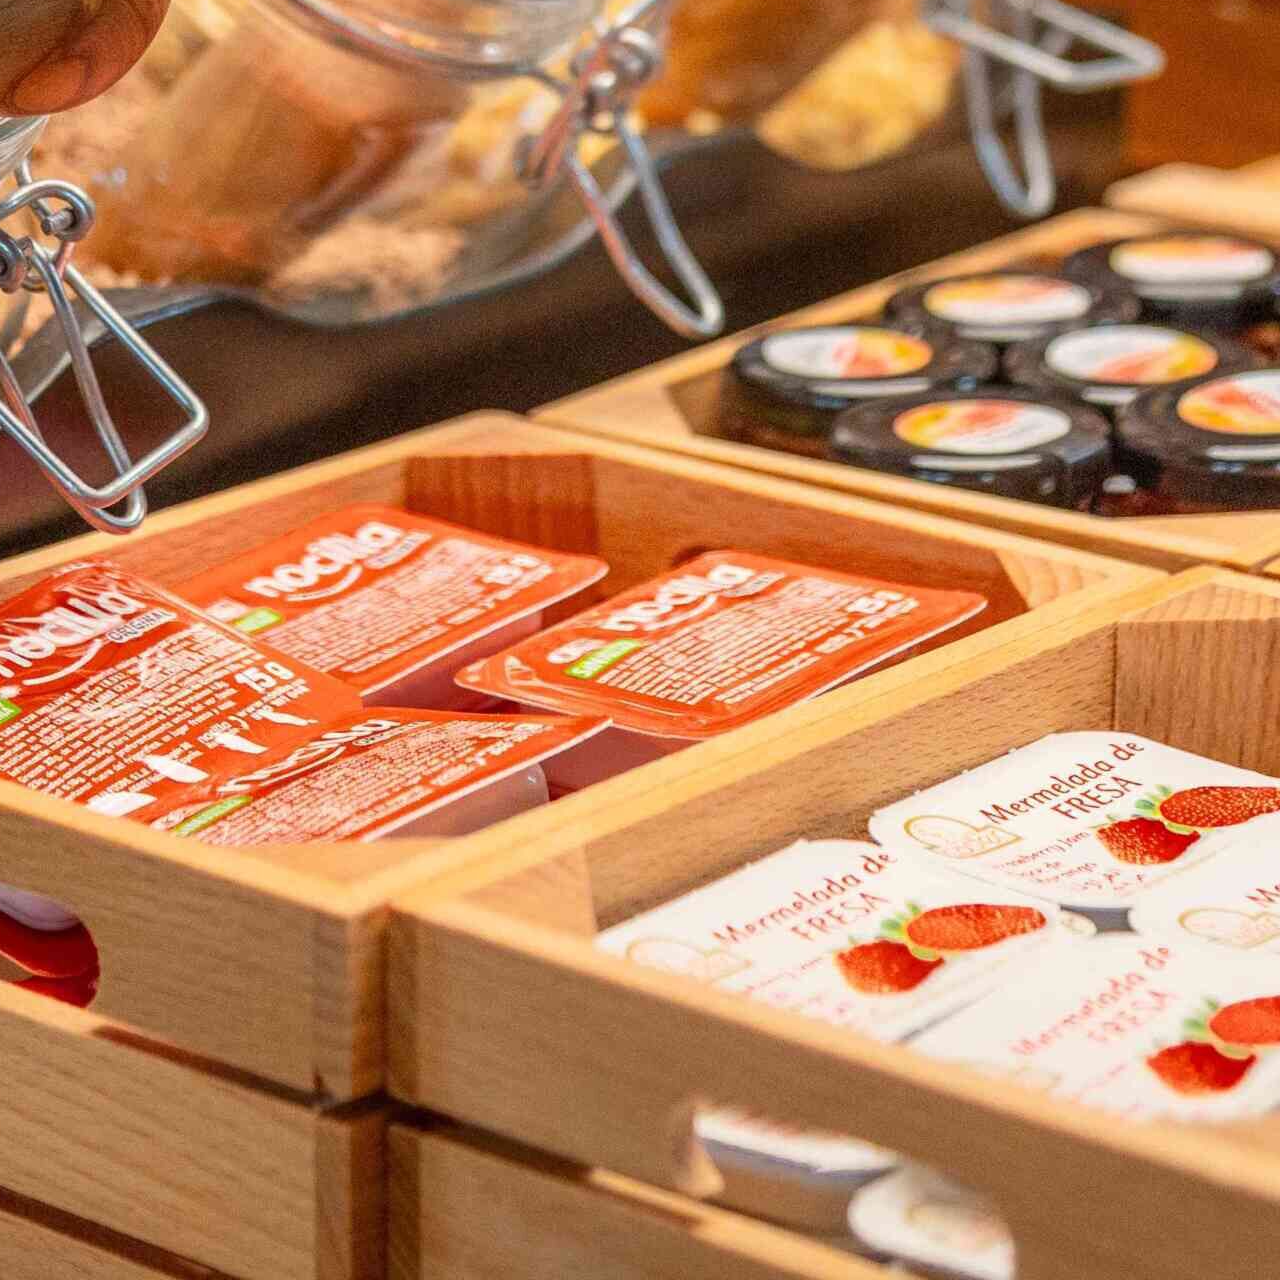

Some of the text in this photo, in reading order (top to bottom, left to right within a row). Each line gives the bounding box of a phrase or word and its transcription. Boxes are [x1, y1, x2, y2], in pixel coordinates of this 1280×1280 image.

[243, 522, 401, 598] nocilla
[107, 609, 172, 642] ORIGINAL
[234, 666, 277, 694] 15
[979, 740, 1145, 824] Mermelada de
[1050, 774, 1143, 820] FRESA
[711, 851, 898, 944] Mermelada de
[789, 891, 890, 942] FRESA
